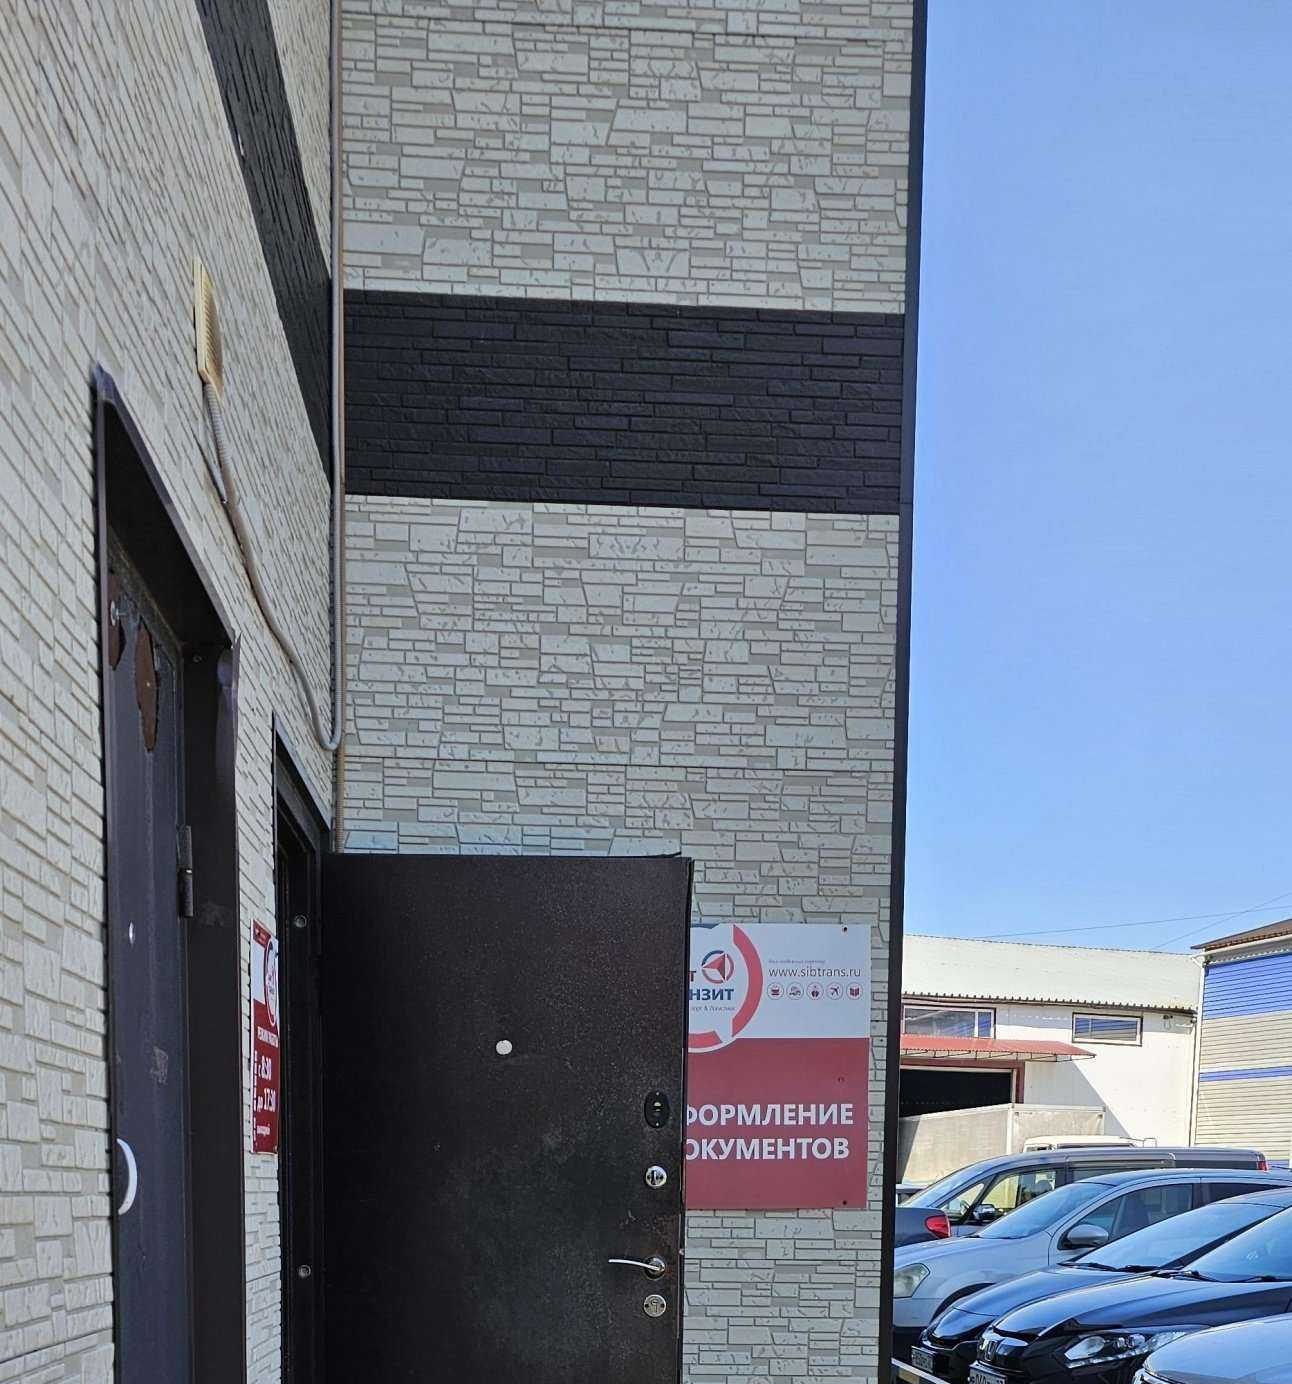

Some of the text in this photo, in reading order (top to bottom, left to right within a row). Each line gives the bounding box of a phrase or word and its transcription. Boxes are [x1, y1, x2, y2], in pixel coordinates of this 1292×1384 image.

[768, 965, 861, 977] www.sibtrans.ru
[688, 988, 735, 1001] НЗИТ
[686, 1103, 854, 1126] ФОРМЛЕНИЕ
[685, 1137, 850, 1160] ОКУМЕНТОВ
